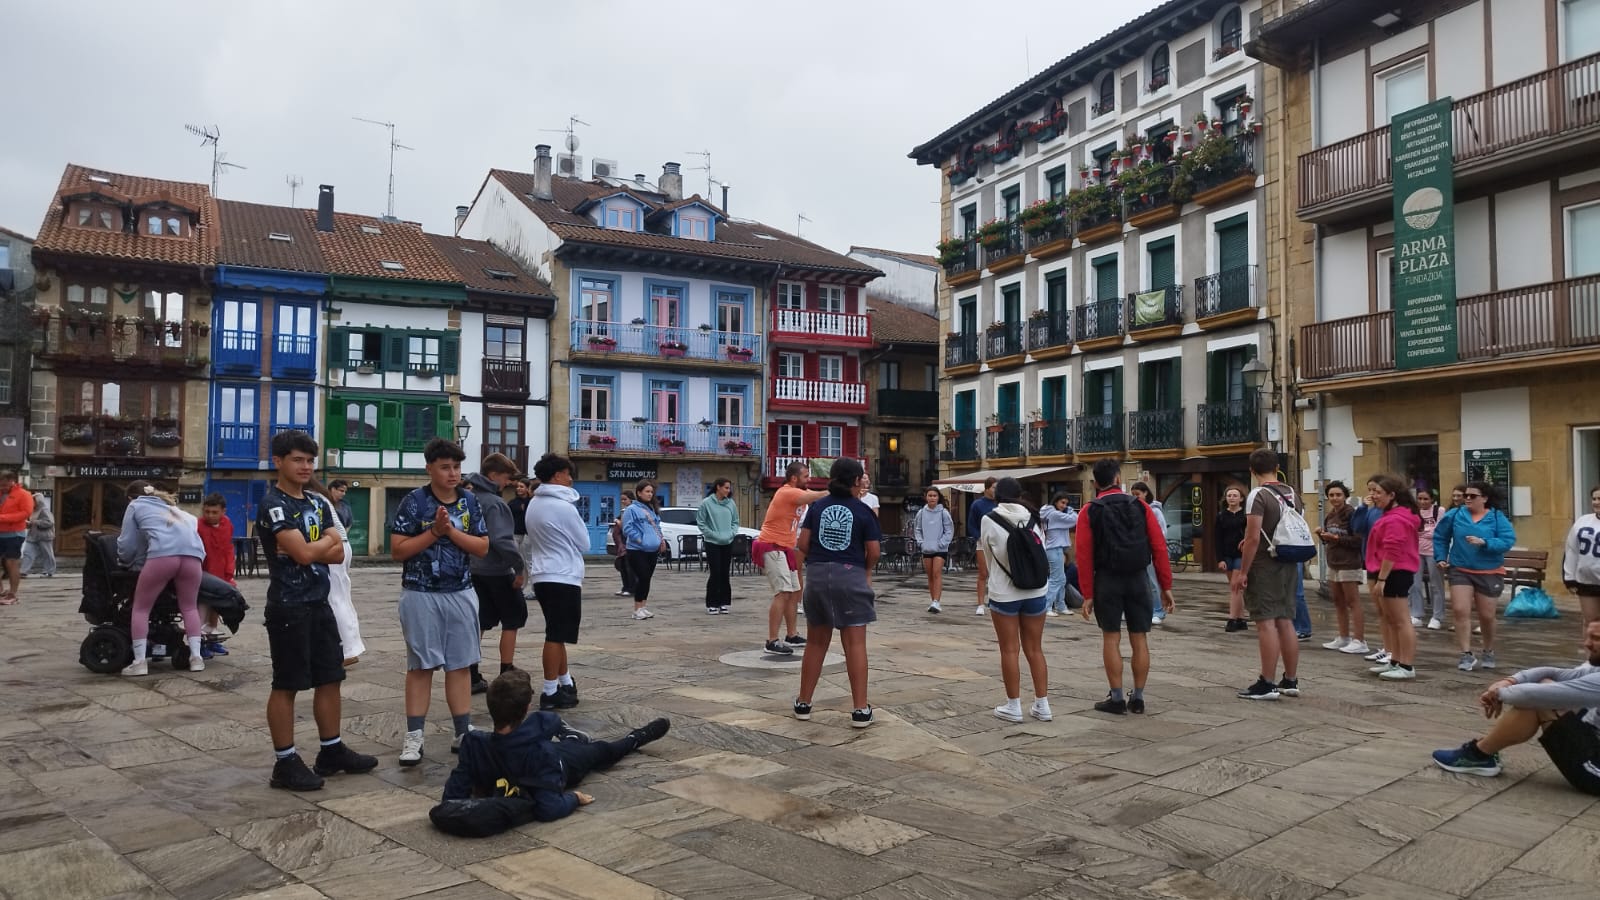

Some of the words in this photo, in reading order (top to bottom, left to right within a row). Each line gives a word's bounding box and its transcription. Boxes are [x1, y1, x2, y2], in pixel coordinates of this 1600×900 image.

[1401, 235, 1447, 257] ARMA
[1400, 252, 1449, 274] PLAZA
[1416, 328, 1424, 336] DE
[80, 466, 108, 476] MIKA
[609, 470, 626, 479] SAN
